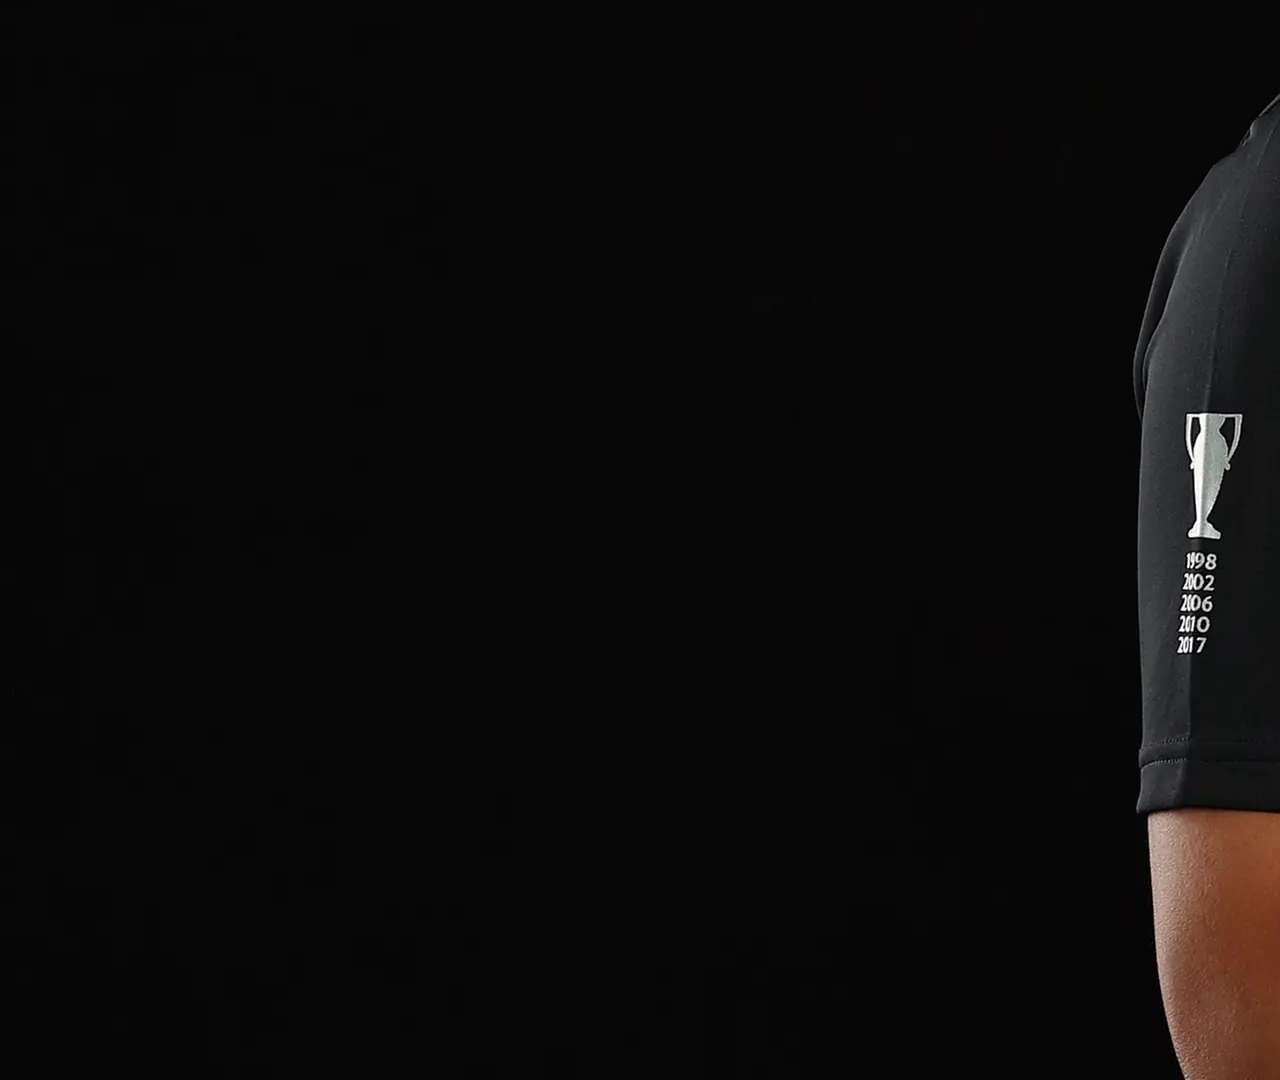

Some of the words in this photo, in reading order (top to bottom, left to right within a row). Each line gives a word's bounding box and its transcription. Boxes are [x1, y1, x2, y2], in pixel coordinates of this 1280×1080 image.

[1186, 551, 1217, 570] 1998
[1182, 573, 1215, 591] 2002
[1180, 594, 1213, 612] 2006
[1178, 615, 1210, 633] 2010
[1177, 636, 1207, 653] 2017
